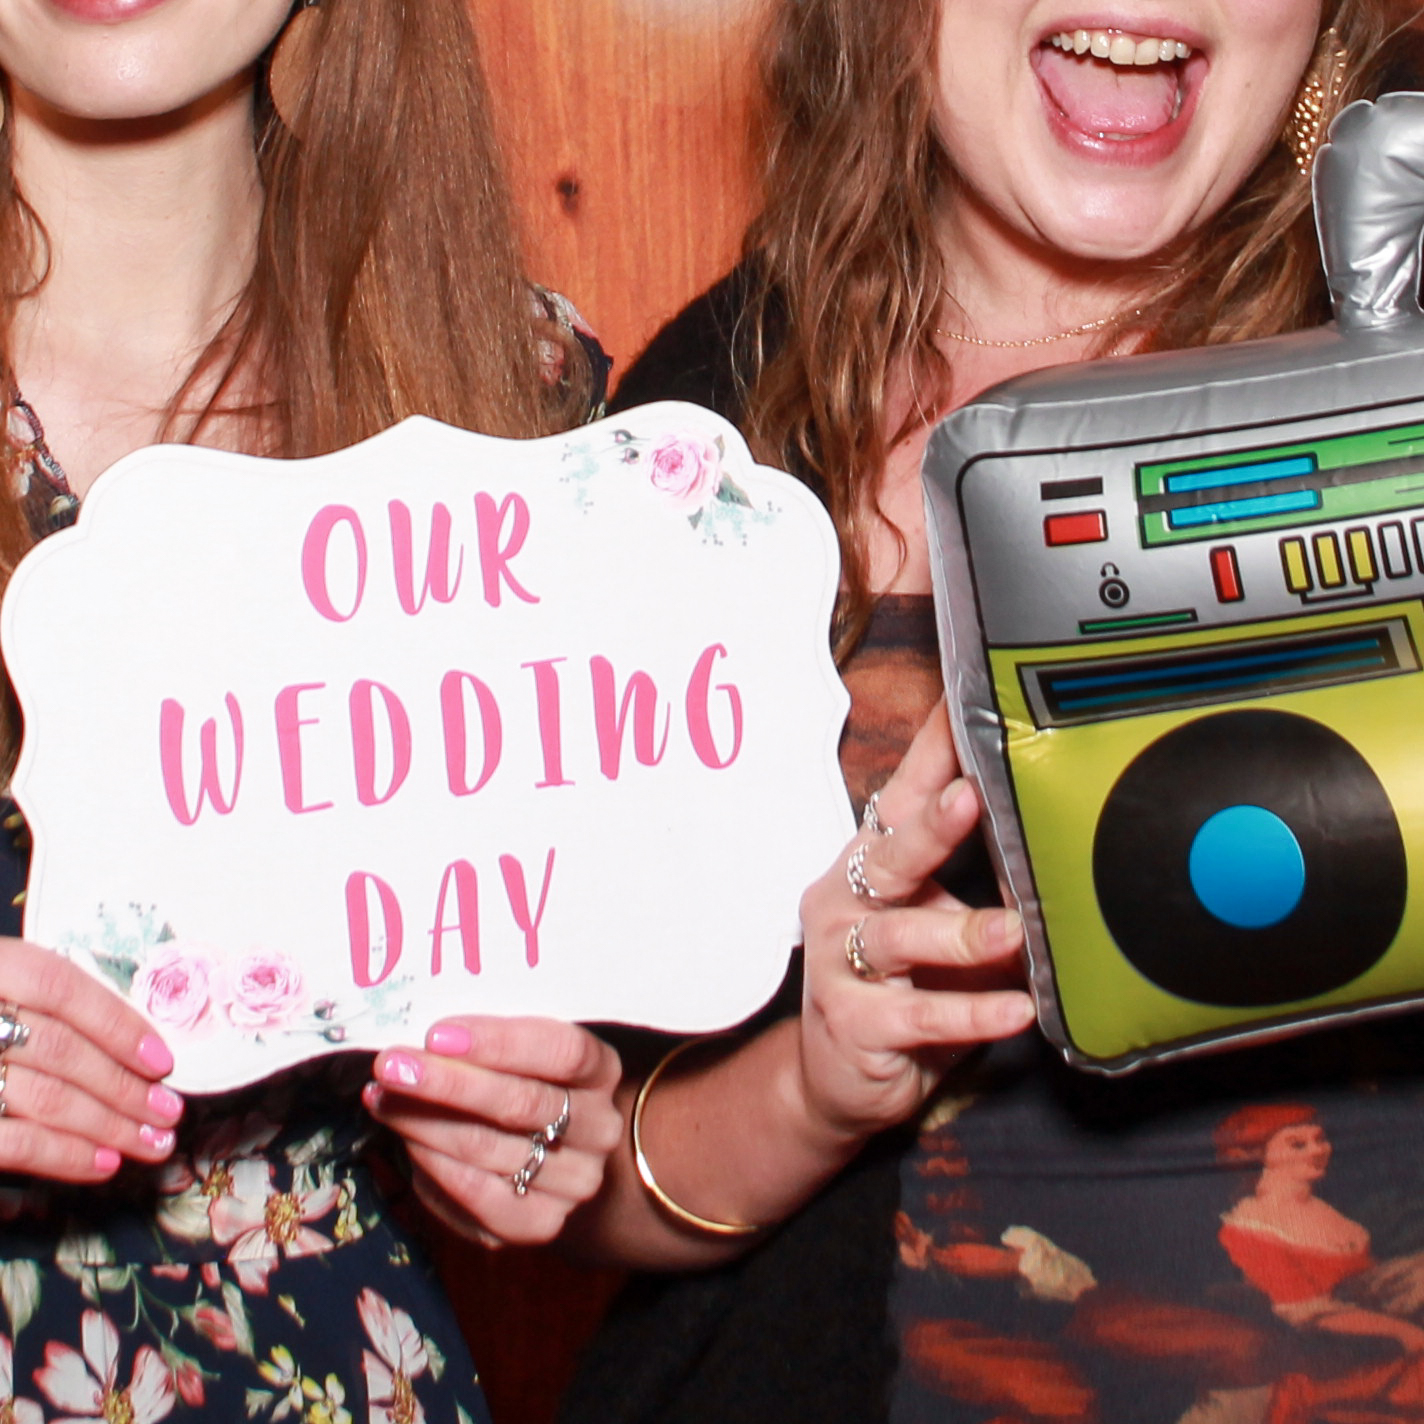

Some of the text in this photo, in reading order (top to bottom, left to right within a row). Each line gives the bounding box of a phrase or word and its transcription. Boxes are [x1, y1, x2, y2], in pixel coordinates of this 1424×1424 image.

[301, 491, 541, 623] OUR
[159, 643, 744, 826] WEDDING
[345, 848, 556, 988] DAY
